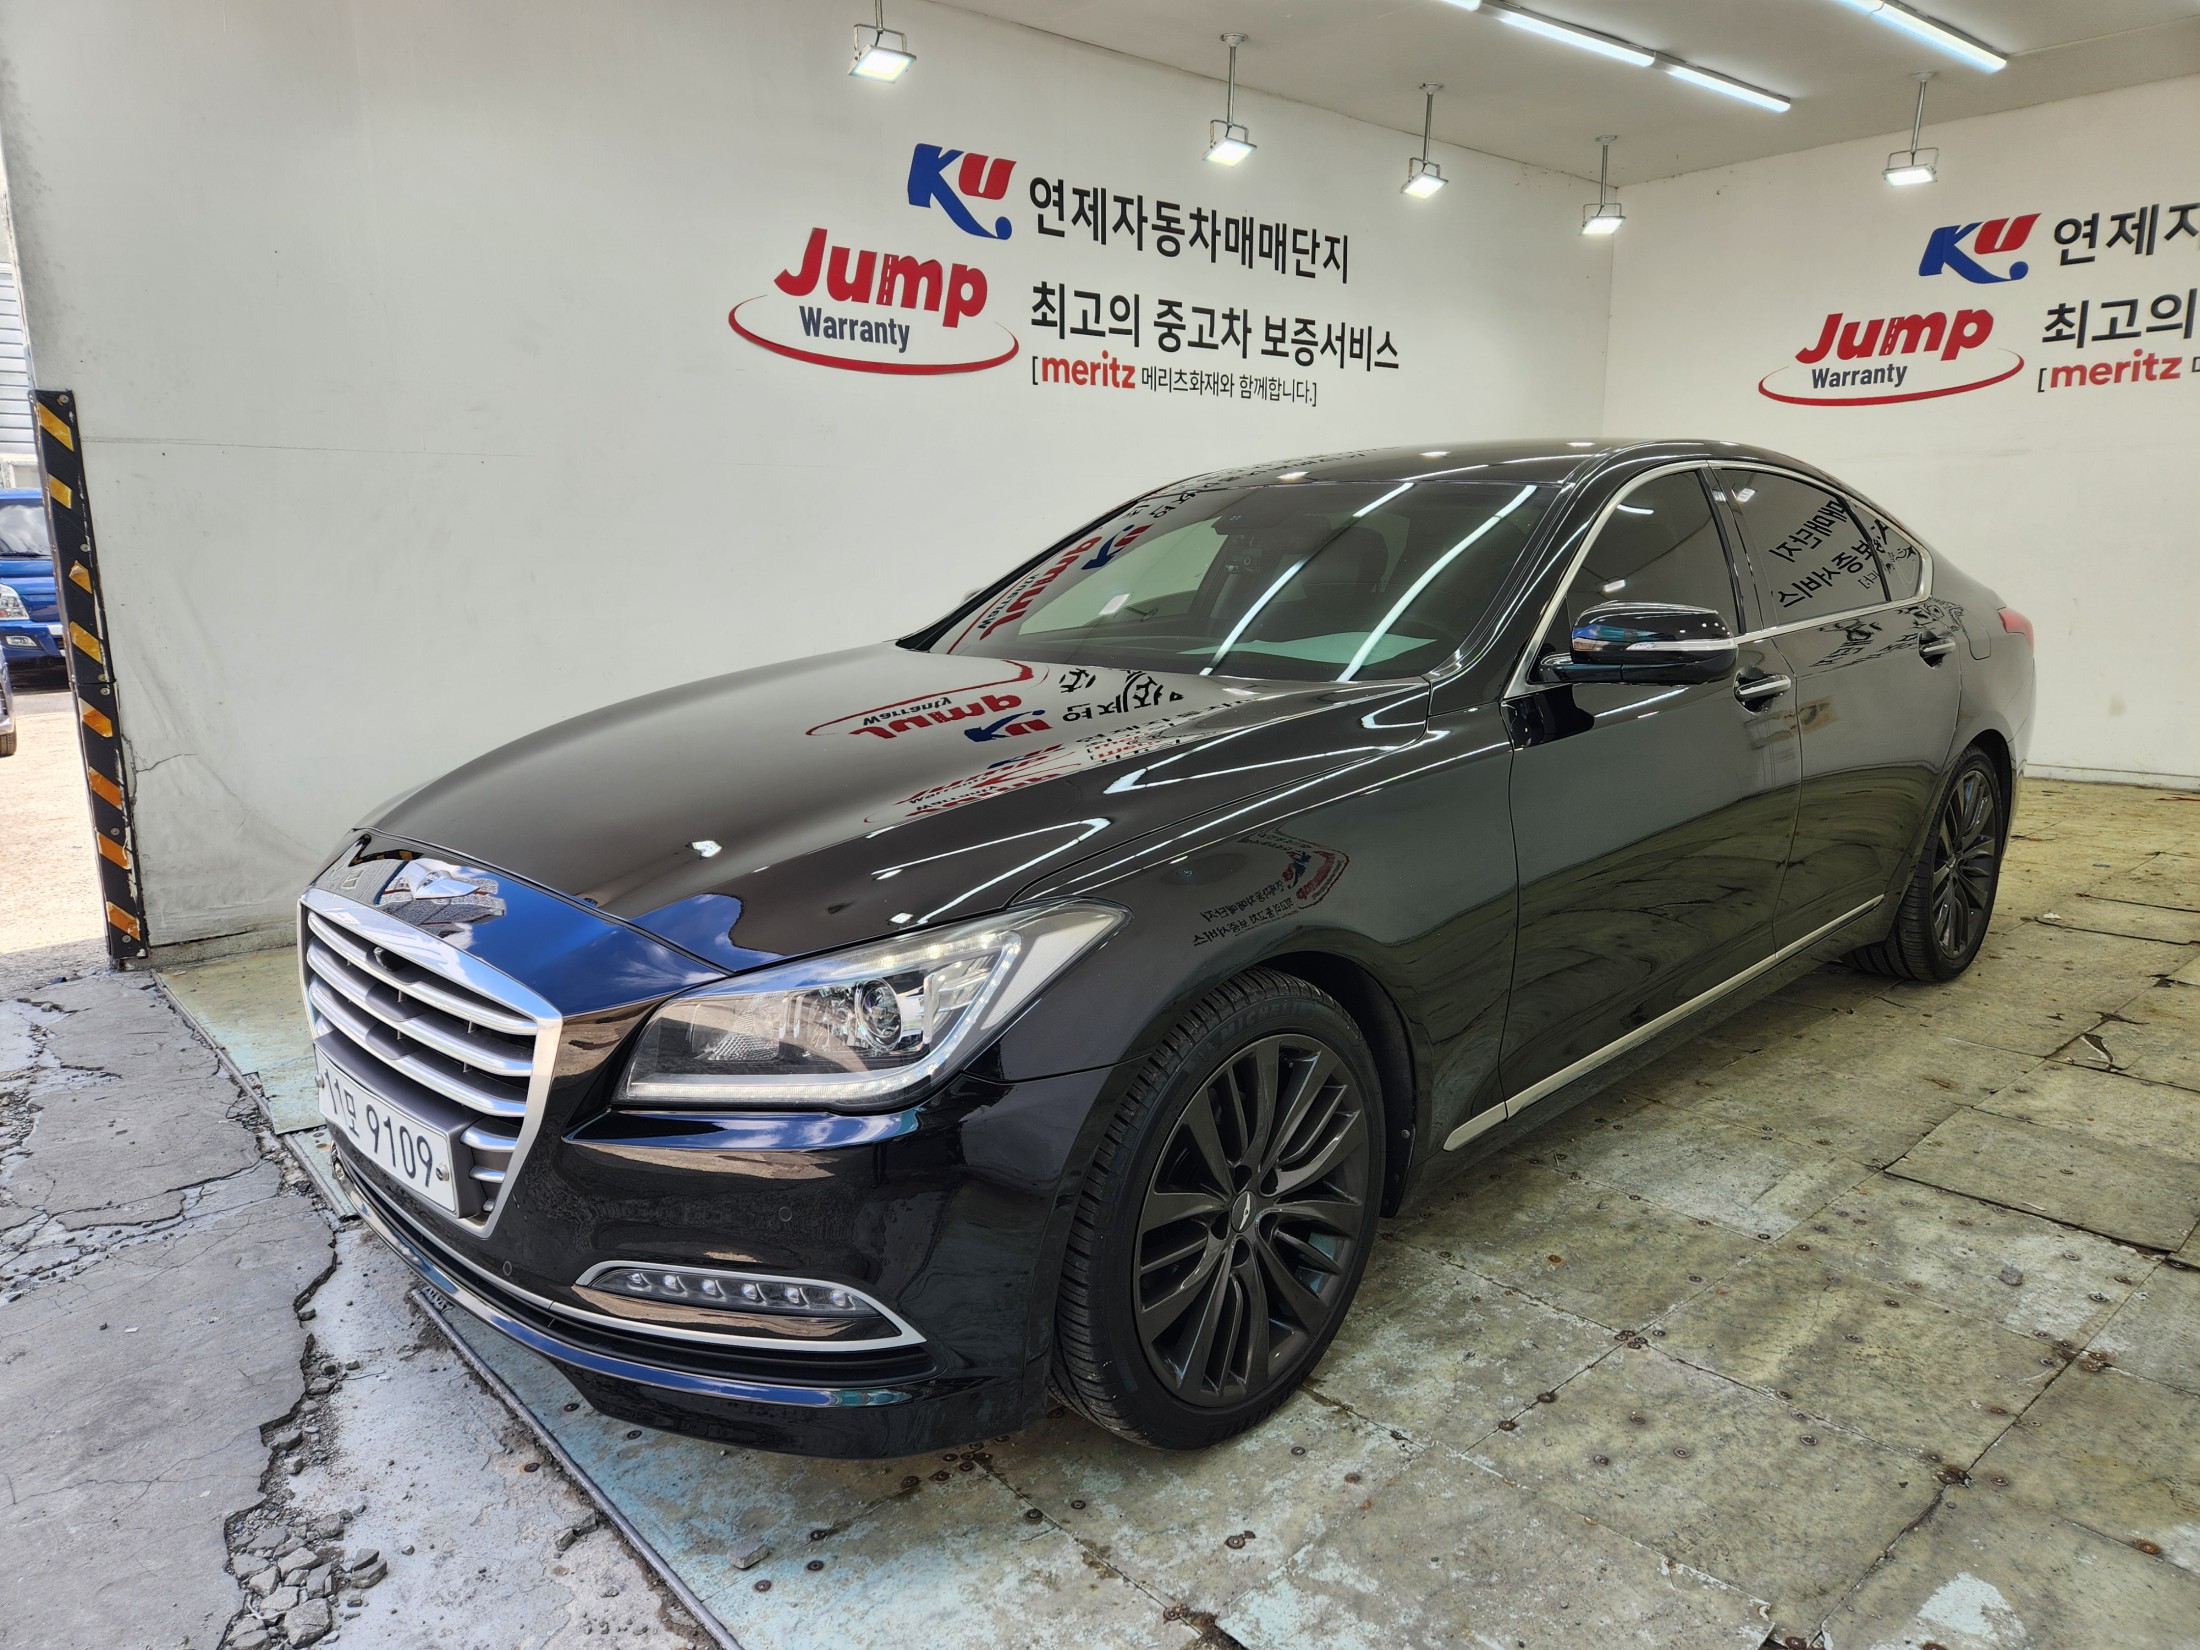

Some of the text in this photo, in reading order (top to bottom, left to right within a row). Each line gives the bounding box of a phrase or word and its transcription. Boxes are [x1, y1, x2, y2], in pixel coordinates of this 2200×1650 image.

[1029, 177, 1349, 284] 연제자동차매매단지
[774, 227, 988, 327] Jump
[799, 305, 910, 352] Warranty
[1030, 281, 1400, 370] 최고의 중고차 보증서비스
[1795, 309, 1993, 364] Jump
[2042, 288, 2198, 348] 최고의
[1141, 364, 1235, 398] 메리츠화재와
[1811, 363, 1907, 388] Warranty
[366, 1104, 433, 1188] 9109
